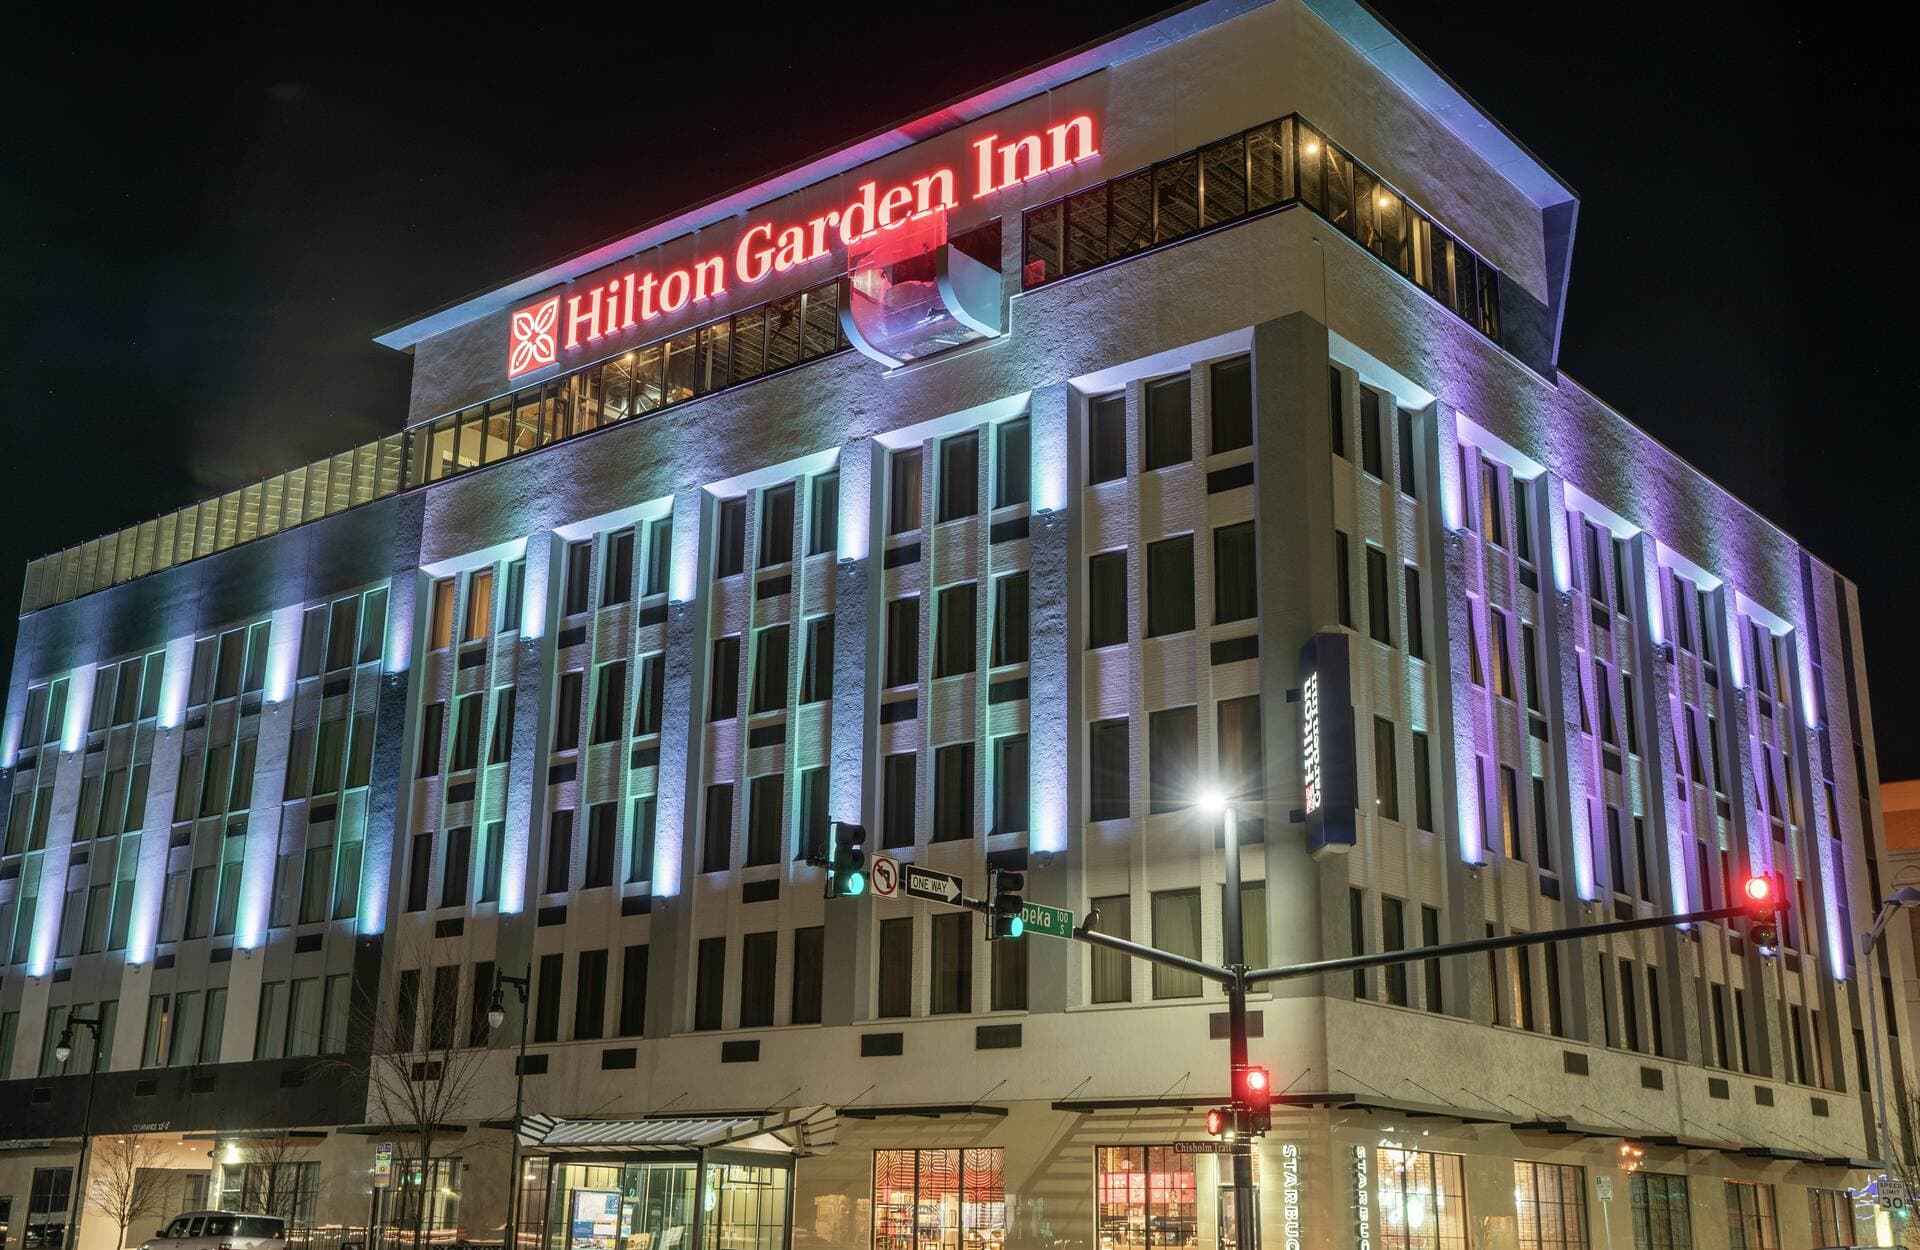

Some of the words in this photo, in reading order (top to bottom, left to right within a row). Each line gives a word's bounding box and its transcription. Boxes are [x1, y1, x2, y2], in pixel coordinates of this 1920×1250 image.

[564, 254, 728, 351] Hilton
[736, 168, 959, 284] Garden
[972, 113, 1101, 199] Inn
[1311, 671, 1319, 717] Inn
[1304, 677, 1314, 786] Hilton
[1313, 718, 1321, 808] Garden
[912, 876, 929, 890] ONE
[931, 879, 947, 894] WAY
[1021, 906, 1051, 928] peka
[1057, 909, 1069, 923] 100
[1059, 923, 1065, 935] S
[1175, 1142, 1212, 1153] Chisholm
[1213, 1142, 1232, 1153] Trail
[1882, 1197, 1903, 1209] 30
